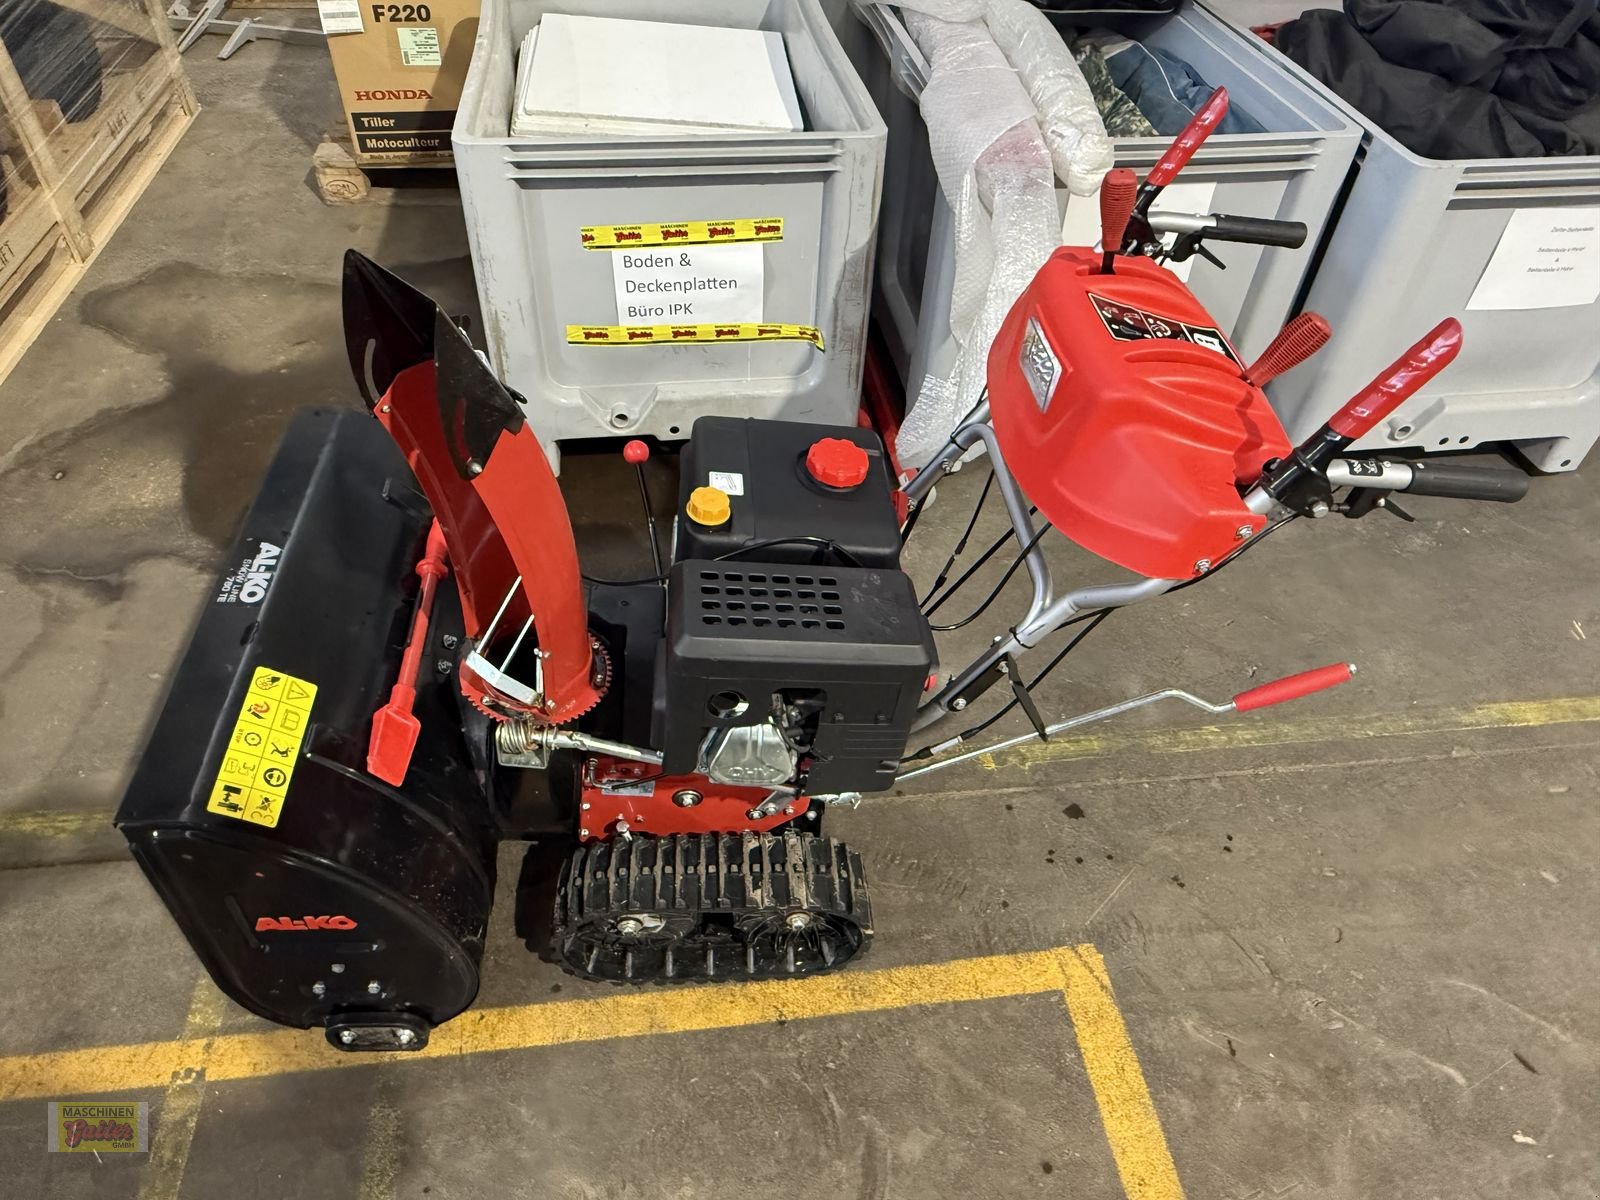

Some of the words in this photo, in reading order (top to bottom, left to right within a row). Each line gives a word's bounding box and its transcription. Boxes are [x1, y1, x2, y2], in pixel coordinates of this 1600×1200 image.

[372, 4, 431, 23] F220
[354, 90, 433, 101] HONDA
[360, 117, 395, 127] Tiller
[366, 137, 440, 149] Motoculteur
[623, 254, 674, 268] Boden
[679, 253, 692, 267] &
[625, 277, 738, 294] Deckenplatten
[628, 305, 664, 317] Büro
[669, 303, 693, 315] IPK
[239, 541, 283, 604] AL-KO
[216, 592, 229, 603] TE
[226, 584, 242, 603] LINE
[255, 915, 358, 931] AL-KO
